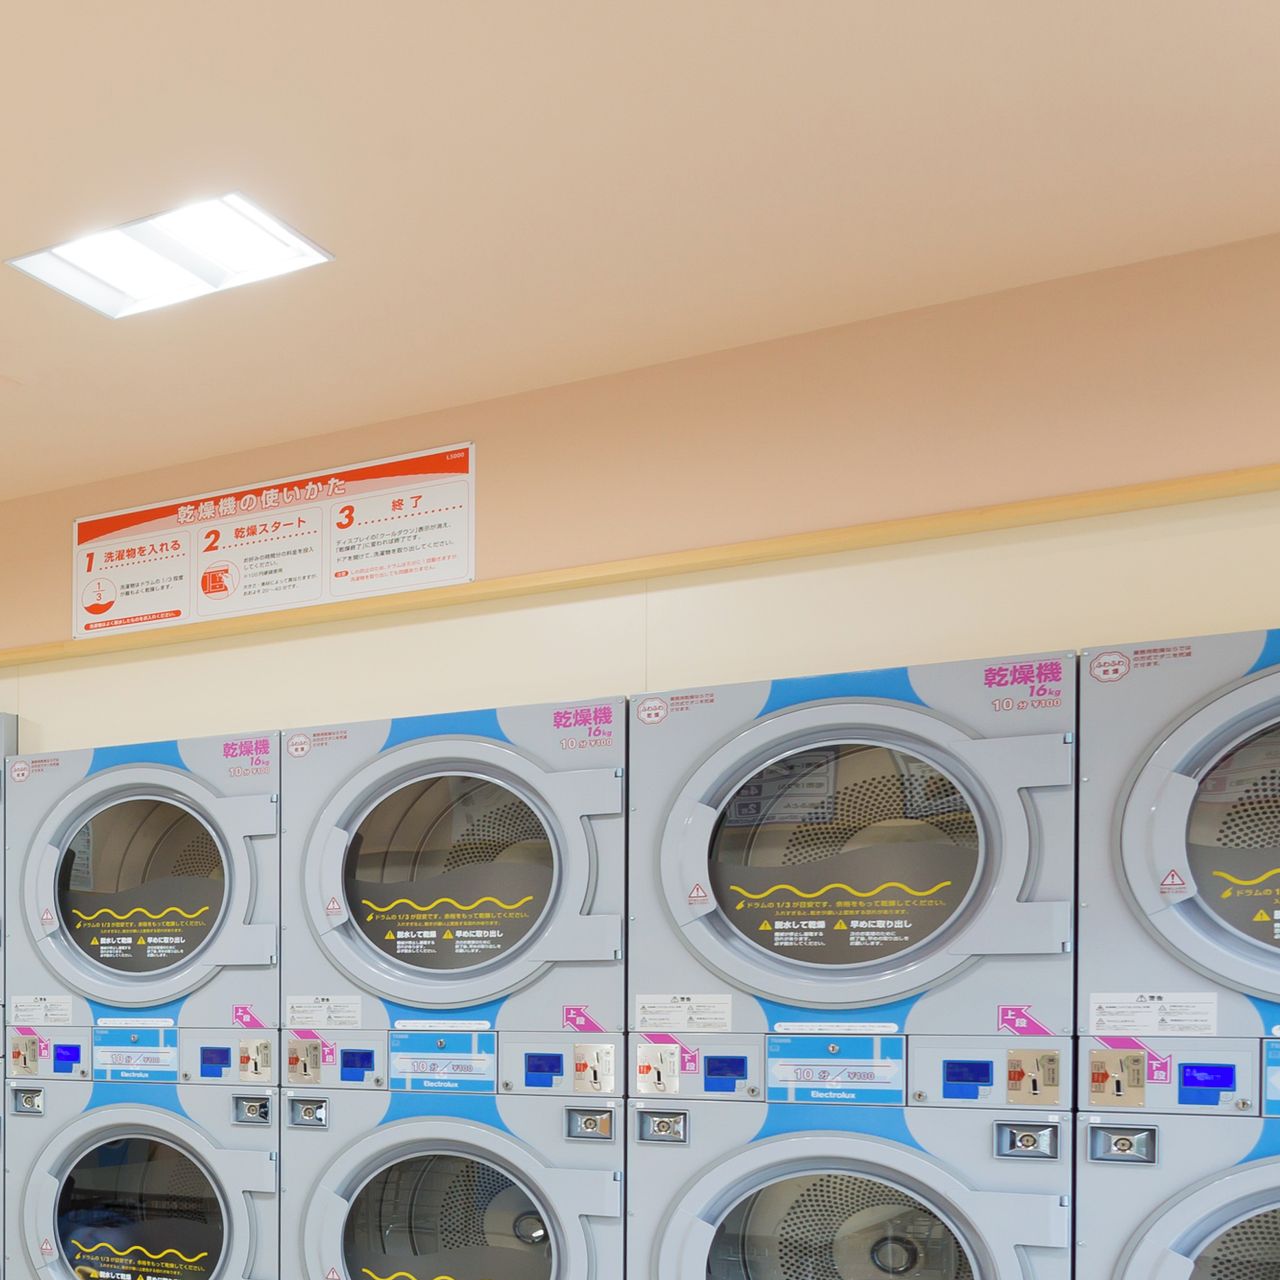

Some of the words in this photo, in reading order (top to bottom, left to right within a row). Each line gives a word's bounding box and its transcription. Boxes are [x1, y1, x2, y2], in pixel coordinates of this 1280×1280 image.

[177, 477, 346, 525] 乾燥機の使いかた
[336, 505, 355, 529] 3
[392, 495, 423, 512] 終了
[203, 529, 221, 553] 2
[234, 517, 306, 540] 乾燥スタート
[86, 552, 95, 573] 1
[104, 540, 181, 563] 洗濯物を入れる
[984, 662, 1063, 689] 乾燥機
[1028, 684, 1062, 698] 16kg
[992, 698, 1014, 712] 10
[553, 706, 613, 729] 乾燥機
[587, 726, 613, 739] 16kg
[224, 739, 270, 758] 乾燥機
[561, 738, 577, 750] 10
[774, 920, 826, 929] 脱水して乾燥
[850, 920, 913, 929] 早めに取り出し
[455, 930, 504, 939] 早めに取り出し
[567, 1009, 586, 1026] 上段
[1005, 1010, 1028, 1028] 上段
[412, 1061, 428, 1073] 10
[682, 1054, 697, 1071] 下段
[120, 1071, 150, 1079] Electrolux
[794, 1068, 814, 1081] 10
[1149, 1061, 1166, 1081] 下段
[423, 1080, 459, 1089] Electrolux
[811, 1091, 857, 1100] Electrolux
